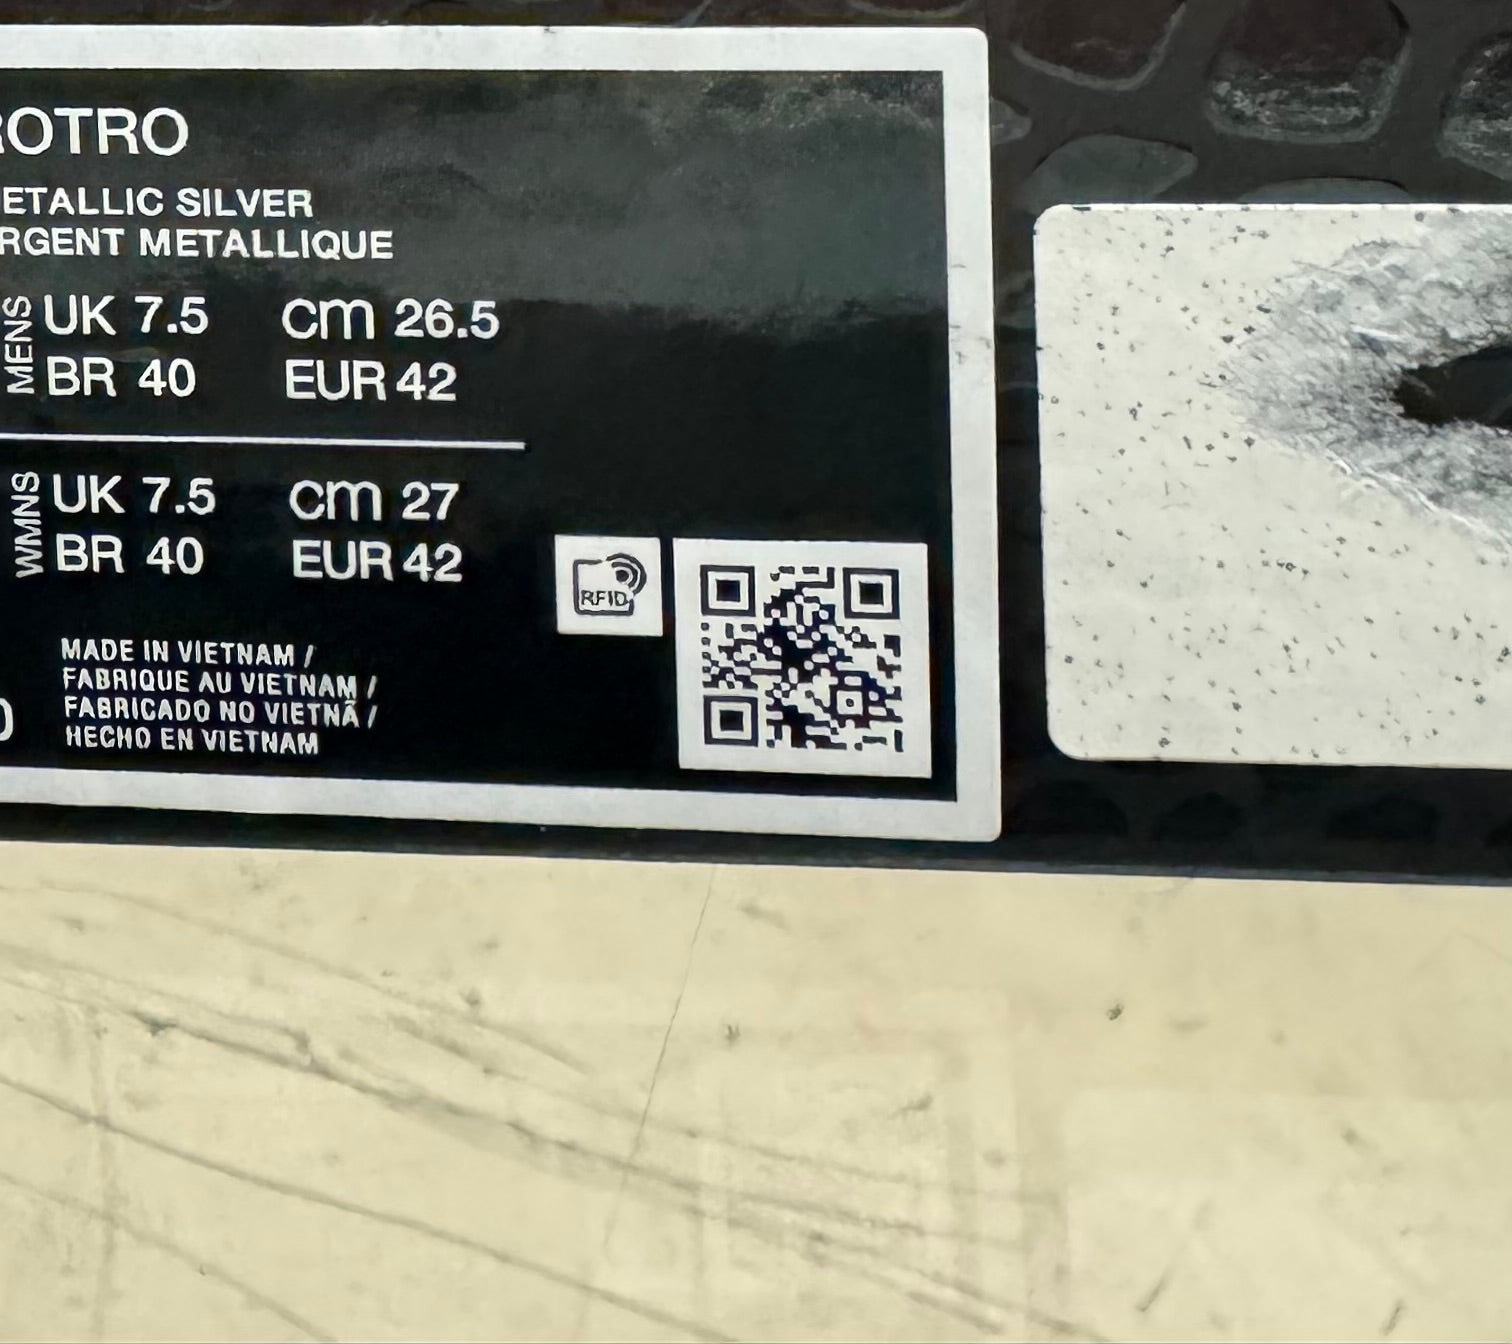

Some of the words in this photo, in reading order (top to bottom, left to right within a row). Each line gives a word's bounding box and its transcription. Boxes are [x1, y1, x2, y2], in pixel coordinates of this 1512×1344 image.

[175, 187, 314, 218] SILVER
[139, 227, 394, 261] METALLIQUE
[43, 294, 117, 336] UK
[134, 295, 209, 335] 7.5
[281, 297, 375, 340] cm
[394, 297, 500, 340] 26.5
[1, 295, 35, 395] MENS
[46, 355, 117, 397] BR
[138, 357, 196, 398] 40
[285, 358, 387, 401] EUR
[396, 361, 457, 402] 42
[52, 473, 126, 514] UK
[142, 476, 216, 516] 7.5
[289, 479, 382, 522] cm
[402, 481, 460, 521] 27
[10, 471, 44, 578] WMNS
[55, 533, 125, 574] BR
[146, 536, 204, 575] 40
[292, 539, 393, 581] EUR
[402, 542, 463, 583] 42
[581, 588, 630, 608] RFID
[61, 637, 134, 662] MADE
[143, 639, 169, 663] IN
[177, 639, 294, 667] VIETNAM
[62, 666, 190, 693] FABRIQUE
[198, 671, 232, 694] AU
[240, 672, 357, 700] VIETNAM
[64, 695, 211, 723] FABRICADO
[219, 700, 255, 724] NO
[264, 699, 360, 727] VIETNÃ
[65, 725, 151, 749] HECHO
[160, 727, 194, 751] EN
[201, 729, 320, 755] VIETNAM
